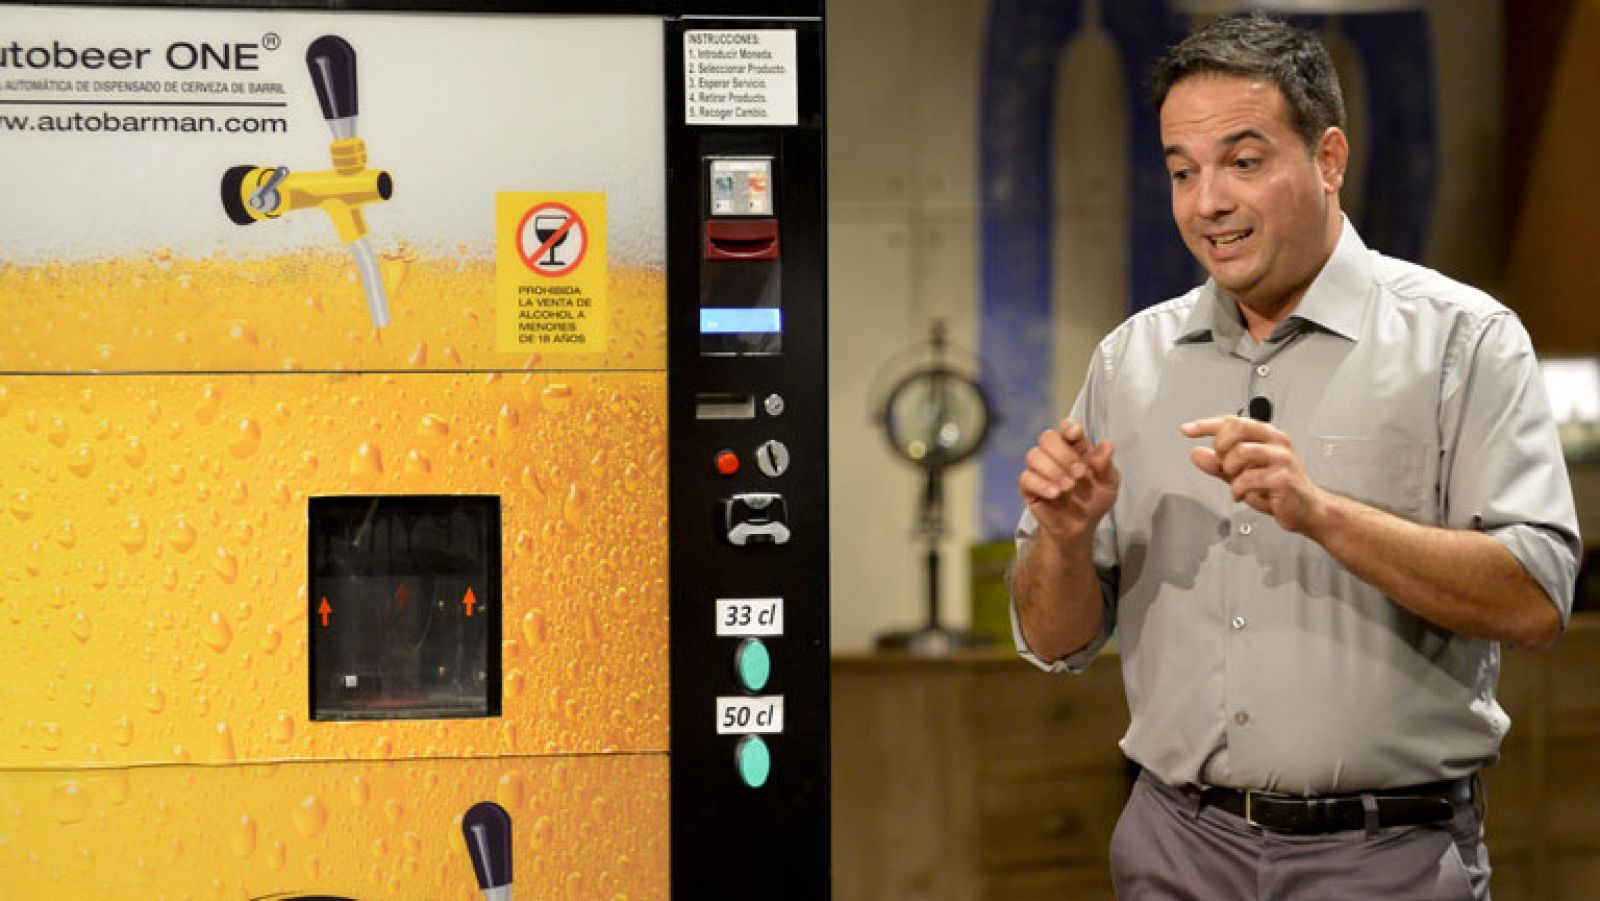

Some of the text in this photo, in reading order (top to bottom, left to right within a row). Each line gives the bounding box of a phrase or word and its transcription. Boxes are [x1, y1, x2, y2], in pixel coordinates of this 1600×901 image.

[689, 49, 696, 59] 1.
[698, 48, 738, 59] Introducir
[689, 63, 696, 73] 2.
[698, 63, 746, 73] Seleccionar
[75, 81, 91, 92] DE
[93, 81, 162, 93] DISPENSADO
[164, 81, 178, 92] DE
[181, 81, 230, 93] CERVEZA
[230, 83, 245, 94] DE
[247, 83, 286, 95] BARRIL
[689, 77, 696, 88] 3.
[698, 77, 729, 90] Esperar
[689, 92, 696, 102] 4.
[698, 92, 726, 102] Retirar
[689, 106, 696, 117] 5.
[699, 106, 734, 120] Recoger
[519, 286, 582, 295] PROHIBIDA
[519, 298, 592, 307] LA VENTA DE
[519, 311, 586, 320] ALCOHOL A
[519, 323, 577, 332] MENORES
[519, 334, 587, 344] DE 18 AÑOS
[725, 603, 776, 627] 33 cl
[722, 704, 774, 727] 50 cl
